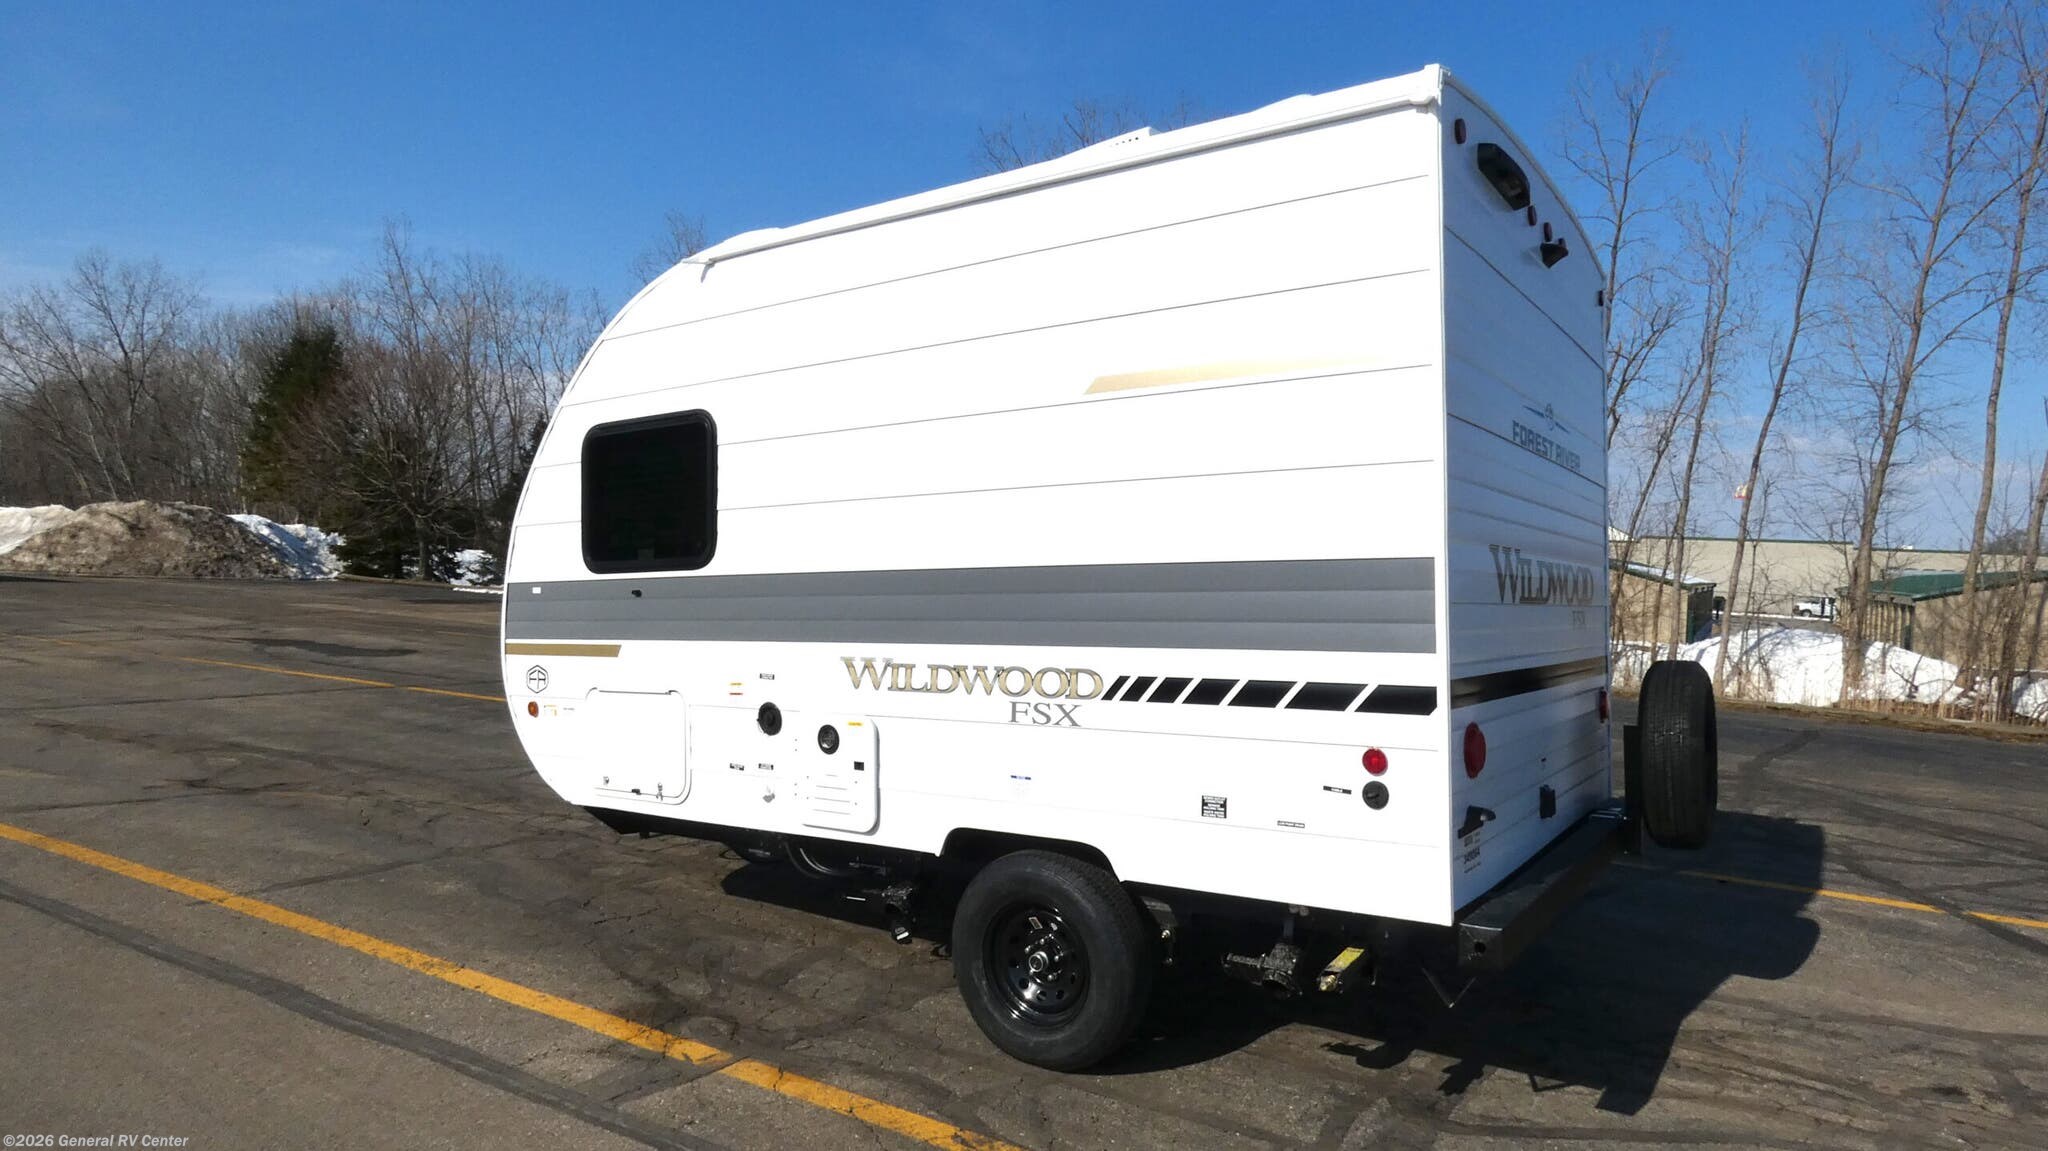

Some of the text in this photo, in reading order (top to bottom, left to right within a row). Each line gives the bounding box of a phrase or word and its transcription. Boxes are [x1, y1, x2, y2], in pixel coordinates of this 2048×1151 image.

[1512, 420, 1581, 473] FOREST RIVER
[1489, 544, 1594, 605] WILDWOOD
[840, 656, 1104, 700] WILDWOOD
[1009, 701, 1081, 727] FSX
